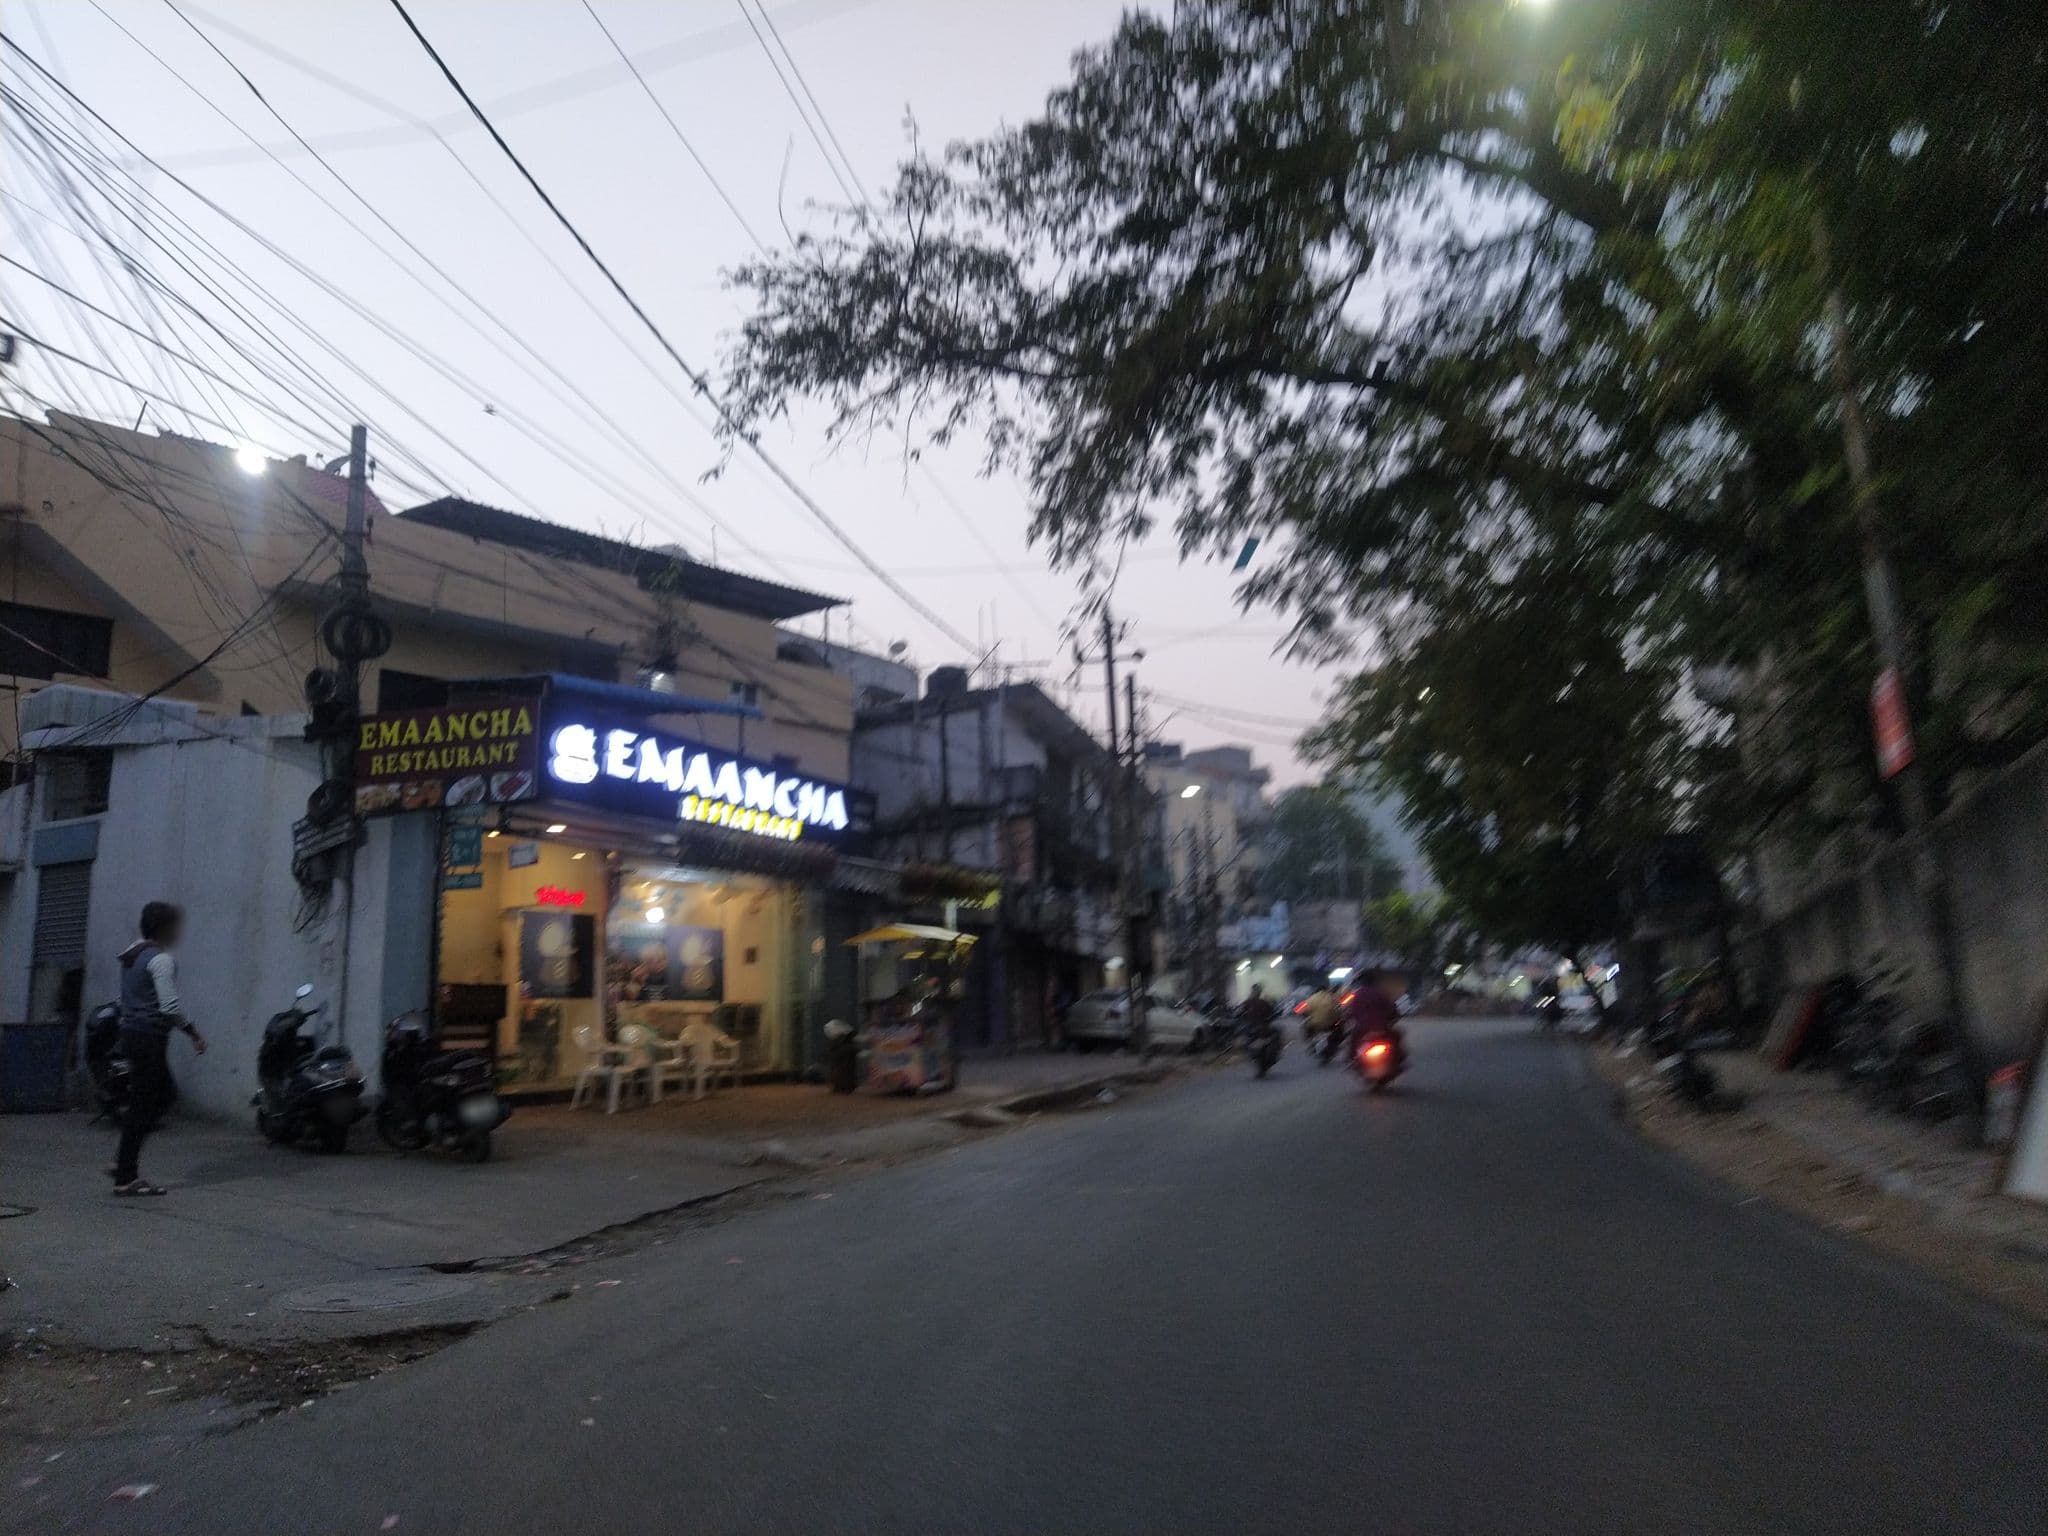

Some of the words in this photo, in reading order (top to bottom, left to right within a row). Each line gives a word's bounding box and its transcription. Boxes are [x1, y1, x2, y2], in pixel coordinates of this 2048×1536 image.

[359, 706, 533, 750] EMAANCHA
[370, 741, 519, 776] RESTAURANT
[606, 728, 849, 831] EMAANCHA
